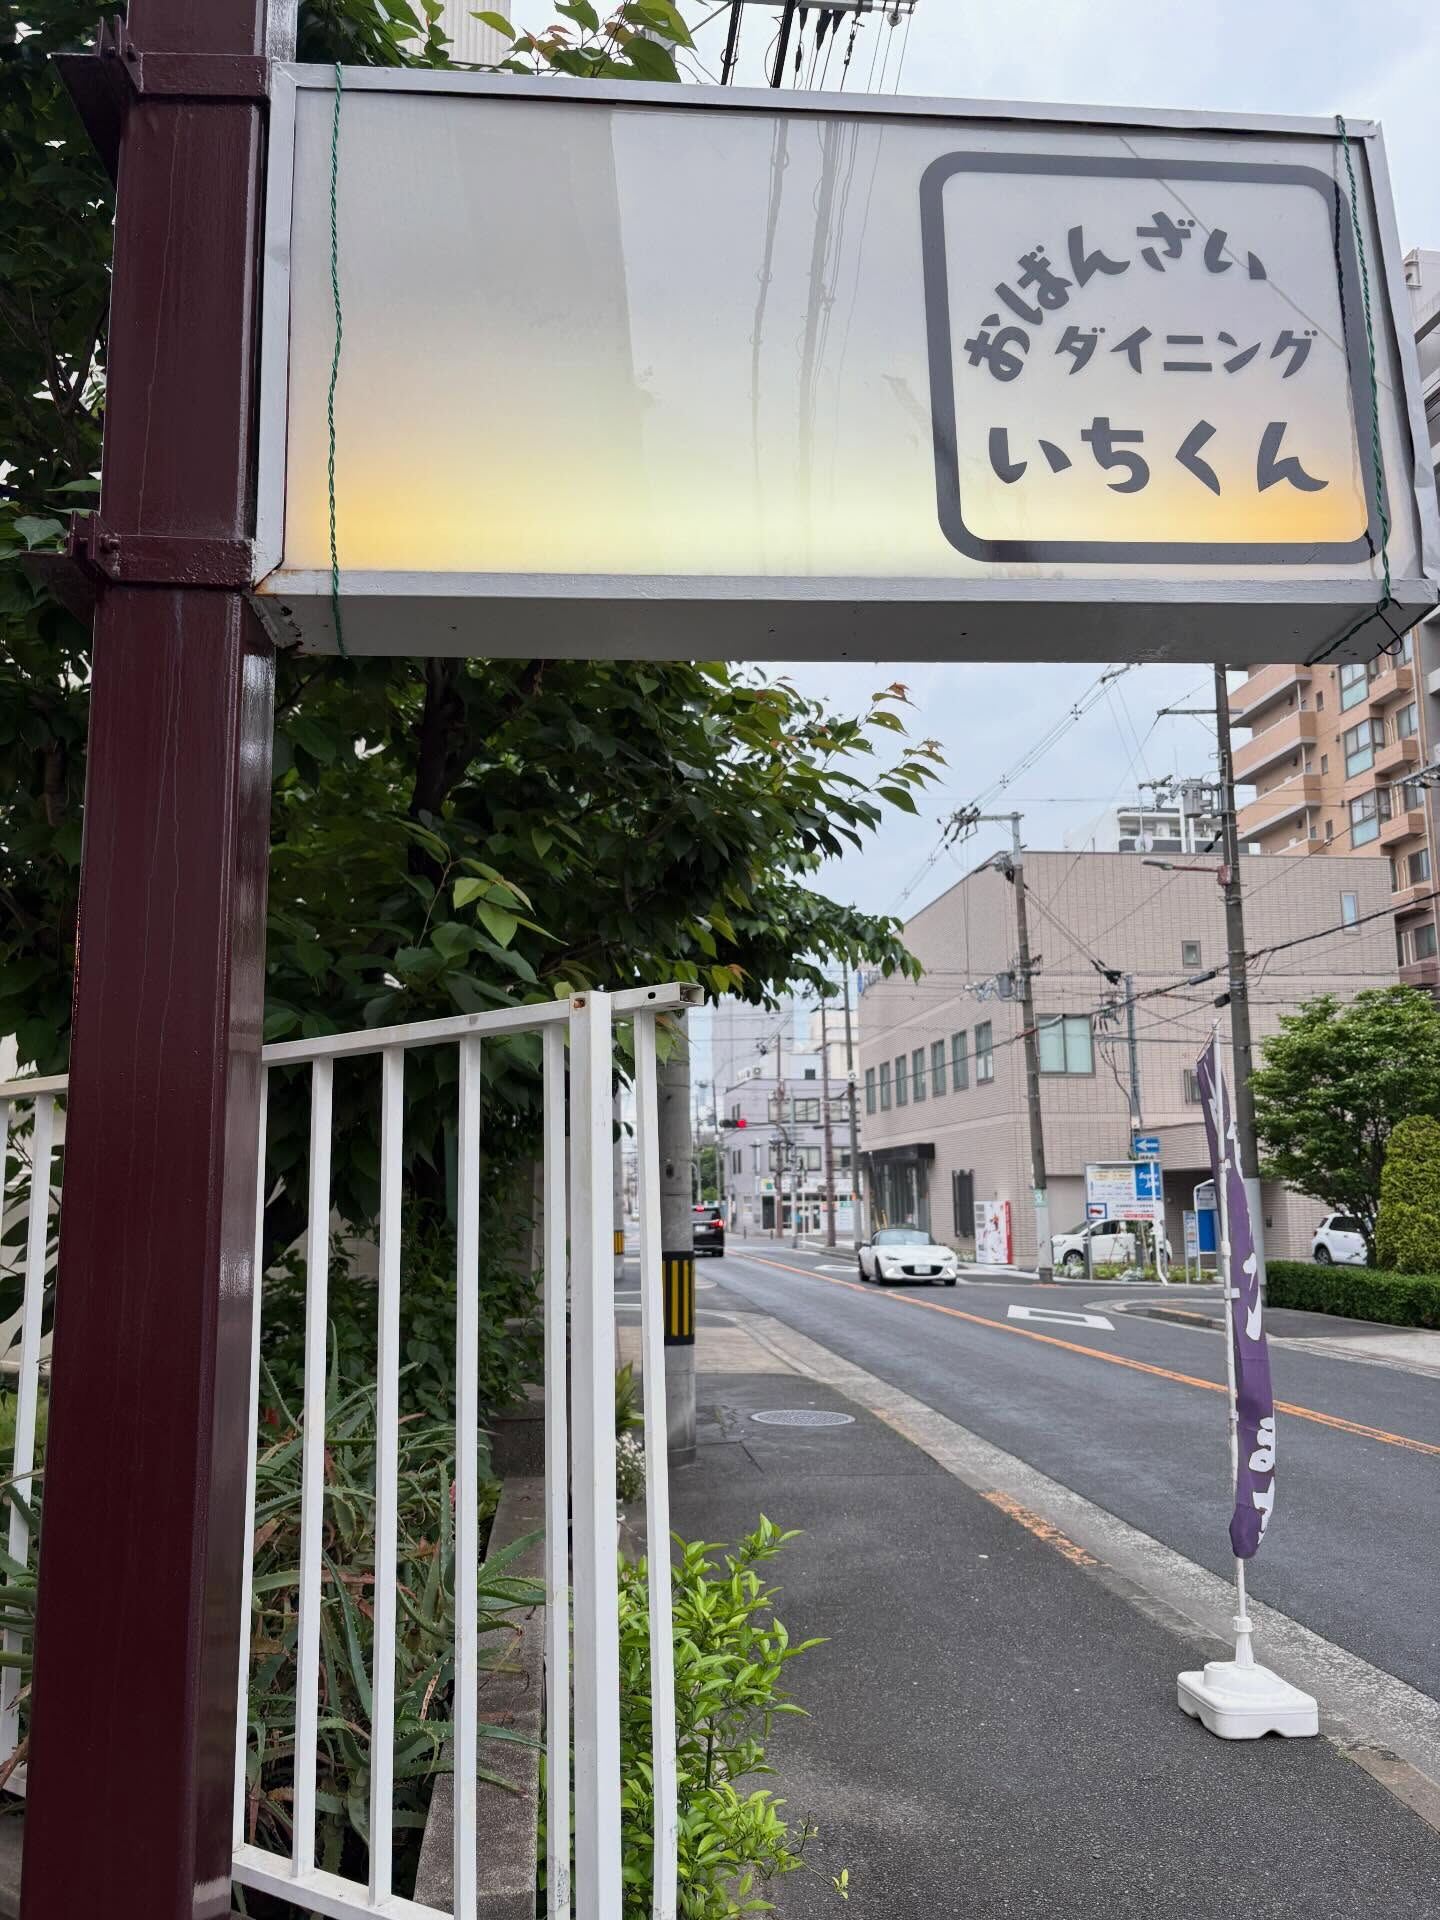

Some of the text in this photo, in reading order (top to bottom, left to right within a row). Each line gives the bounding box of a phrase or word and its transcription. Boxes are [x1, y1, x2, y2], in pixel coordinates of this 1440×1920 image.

[963, 211, 1267, 382] おばんざい
[1055, 325, 1318, 378] ダイニング
[988, 416, 1330, 496] いちくん
